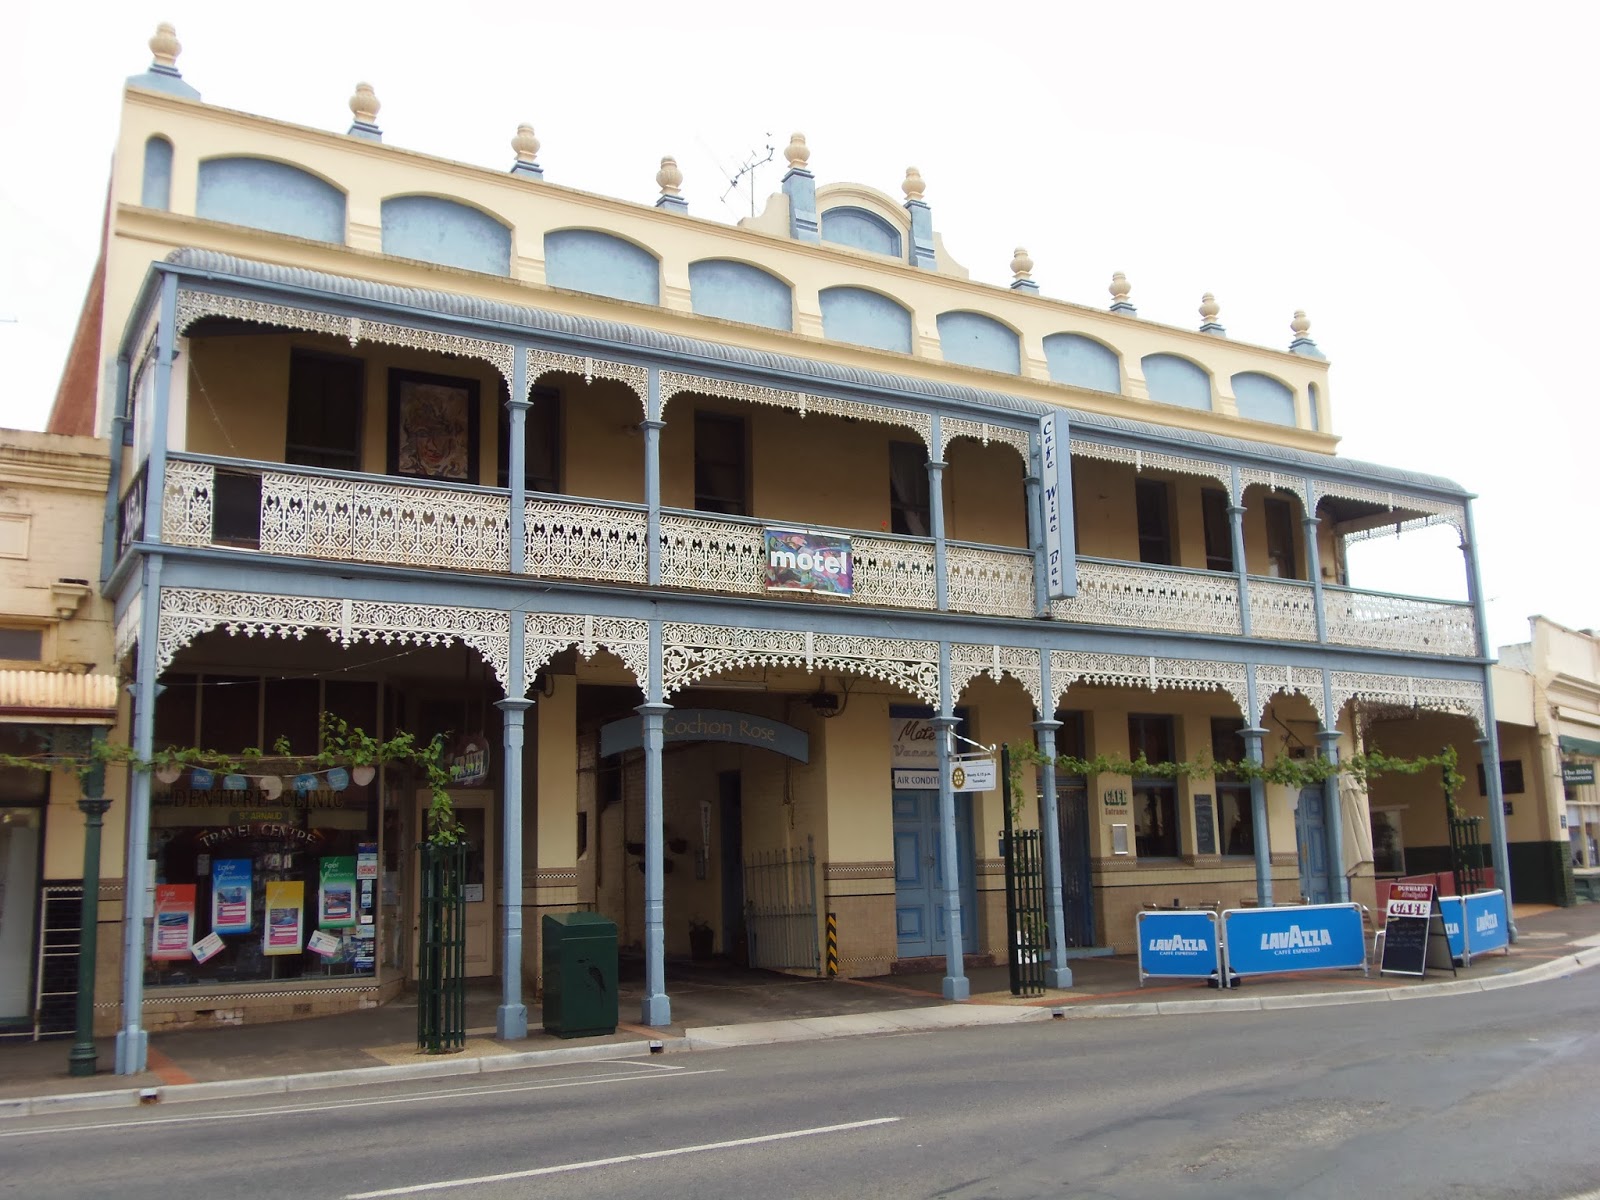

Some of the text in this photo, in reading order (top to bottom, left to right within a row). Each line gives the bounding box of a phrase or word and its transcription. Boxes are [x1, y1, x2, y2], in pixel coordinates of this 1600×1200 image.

[1045, 483, 1058, 533] Wine
[770, 551, 847, 575] motel
[1049, 550, 1060, 586] Bar
[663, 712, 732, 737] Cochon
[739, 719, 776, 742] Rose
[898, 720, 937, 742] Mote
[1565, 774, 1593, 782] Museum
[1576, 767, 1593, 775] Bible
[897, 776, 939, 786] AIR CONDITI
[174, 789, 345, 809] DENTURE CLINIC
[251, 812, 282, 820] ARNAUD
[1105, 807, 1128, 816] Entrance
[200, 823, 317, 847] TRAVEL CENTRE
[1389, 902, 1428, 916] CAFE
[1149, 934, 1208, 952] LAVAZZA
[1259, 924, 1333, 951] LAVAZZA
[1292, 946, 1321, 955] ESPRESSO
